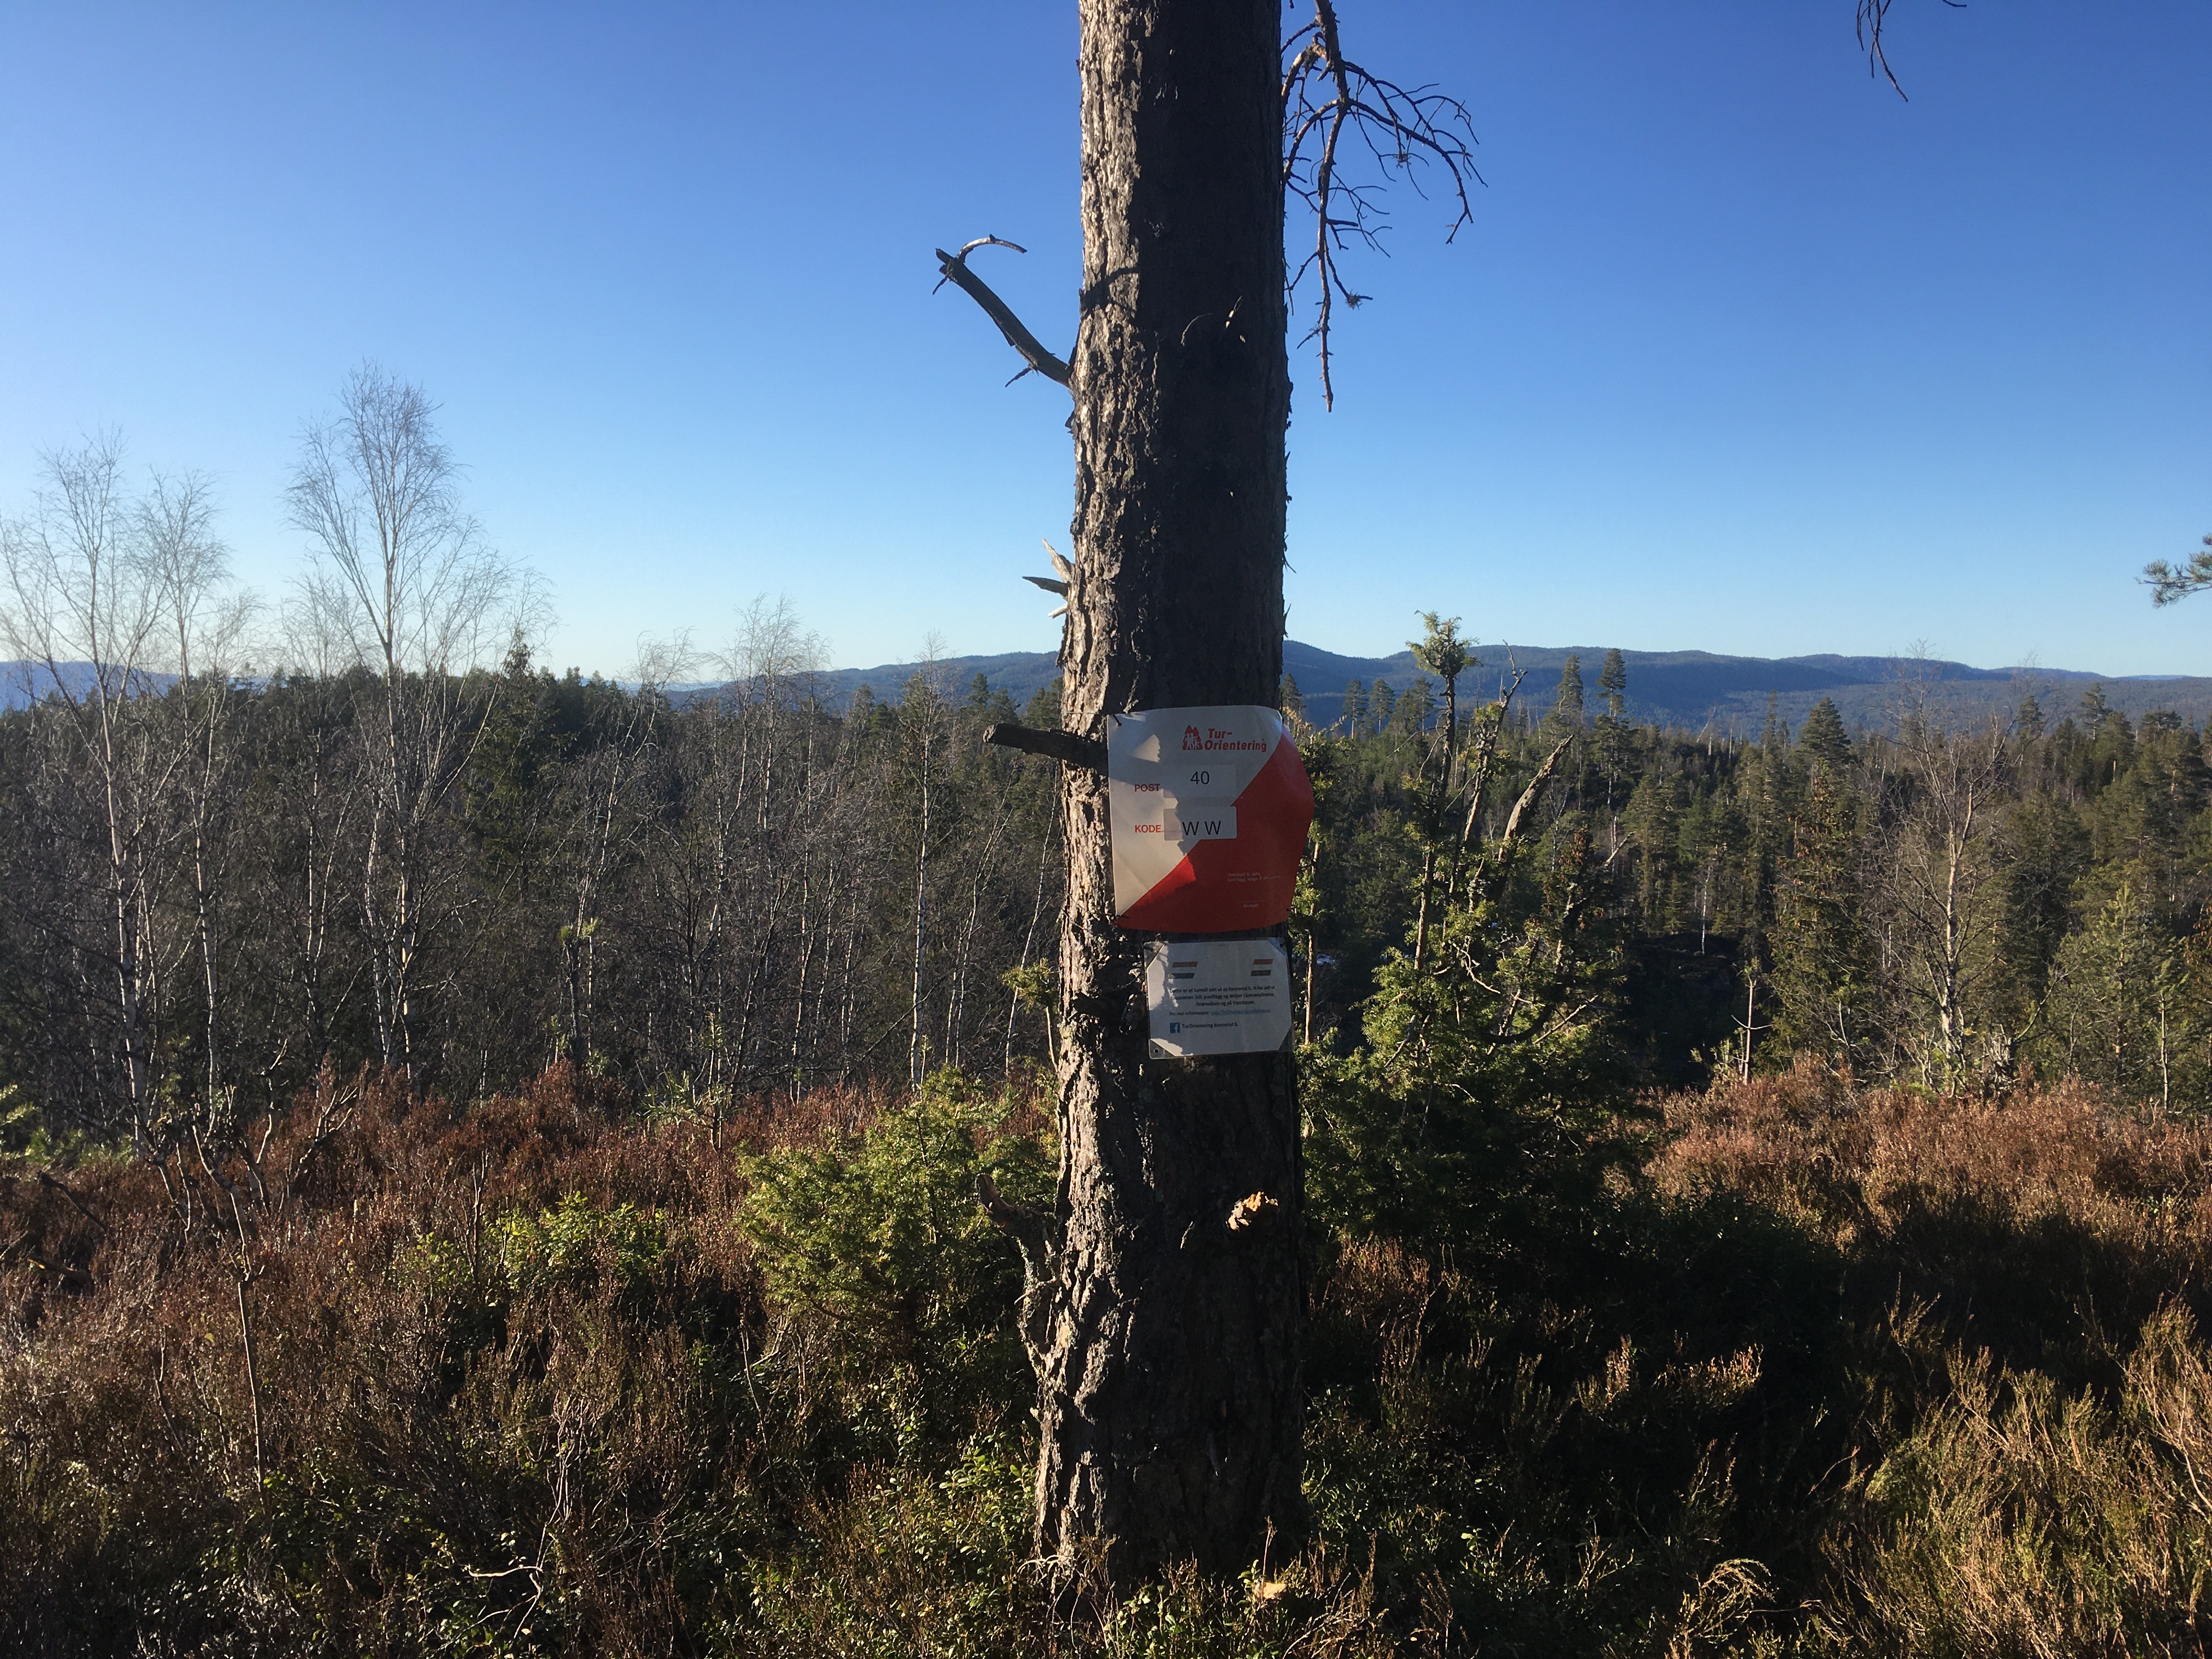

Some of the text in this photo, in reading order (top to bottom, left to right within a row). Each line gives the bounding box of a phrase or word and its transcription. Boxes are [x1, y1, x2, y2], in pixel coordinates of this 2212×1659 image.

[1207, 728, 1233, 739] Tur-
[1204, 740, 1267, 752] Orientering
[1190, 771, 1210, 785] 40
[1134, 783, 1160, 792] POST
